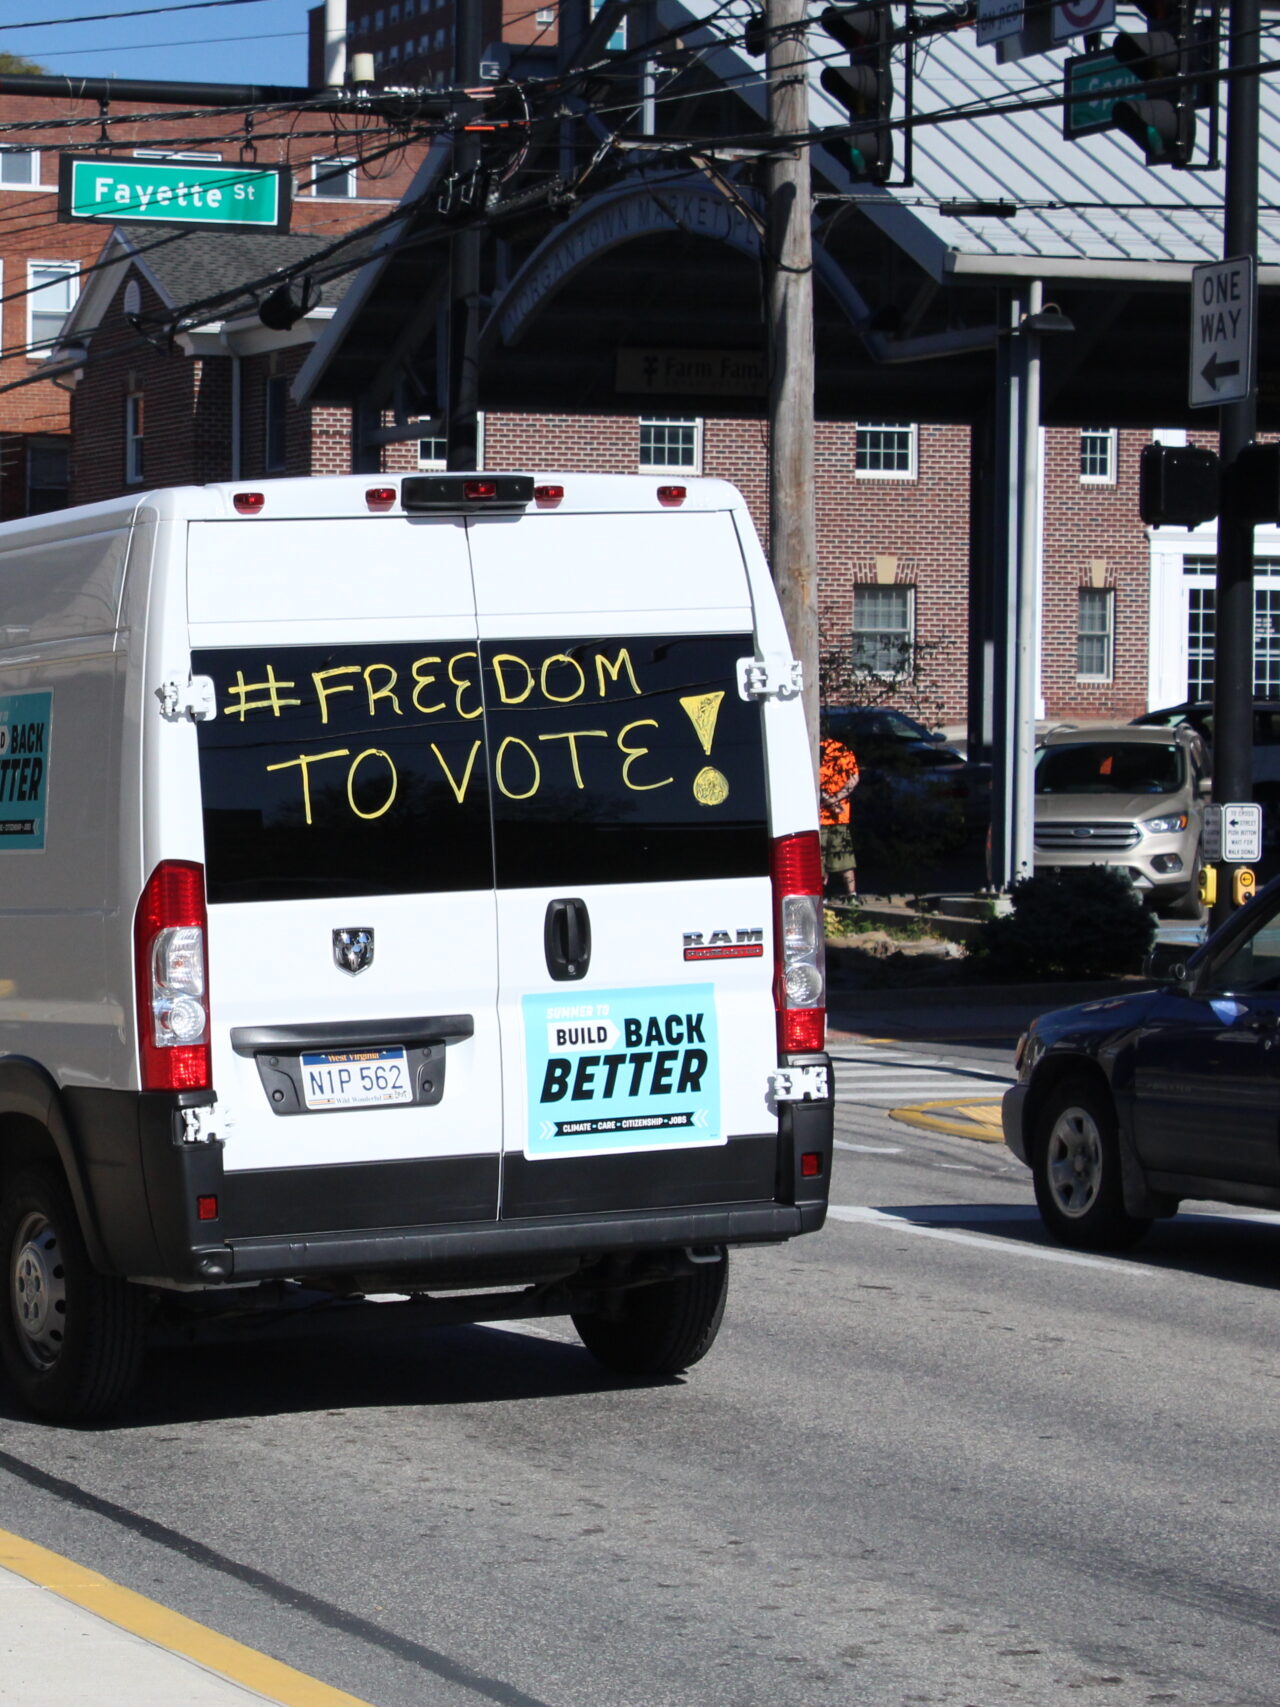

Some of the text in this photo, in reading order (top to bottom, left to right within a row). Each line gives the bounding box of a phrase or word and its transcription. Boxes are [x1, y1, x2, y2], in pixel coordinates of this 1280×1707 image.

[95, 177, 255, 211] Fayette St
[1202, 271, 1240, 306] ONE
[1200, 308, 1241, 344] WAY
[224, 648, 641, 724] #FREEDOM
[11, 723, 45, 754] BACK
[267, 691, 730, 825] TO VOTE!
[683, 927, 763, 946] RAM
[547, 1004, 610, 1019] SUMMER TO
[556, 1013, 706, 1048] BUILD BACK
[360, 1065, 403, 1091] 562
[540, 1048, 708, 1103] BETTER
[563, 1115, 687, 1133] CLIMATE CARE CITIZENSHIP JOBS
